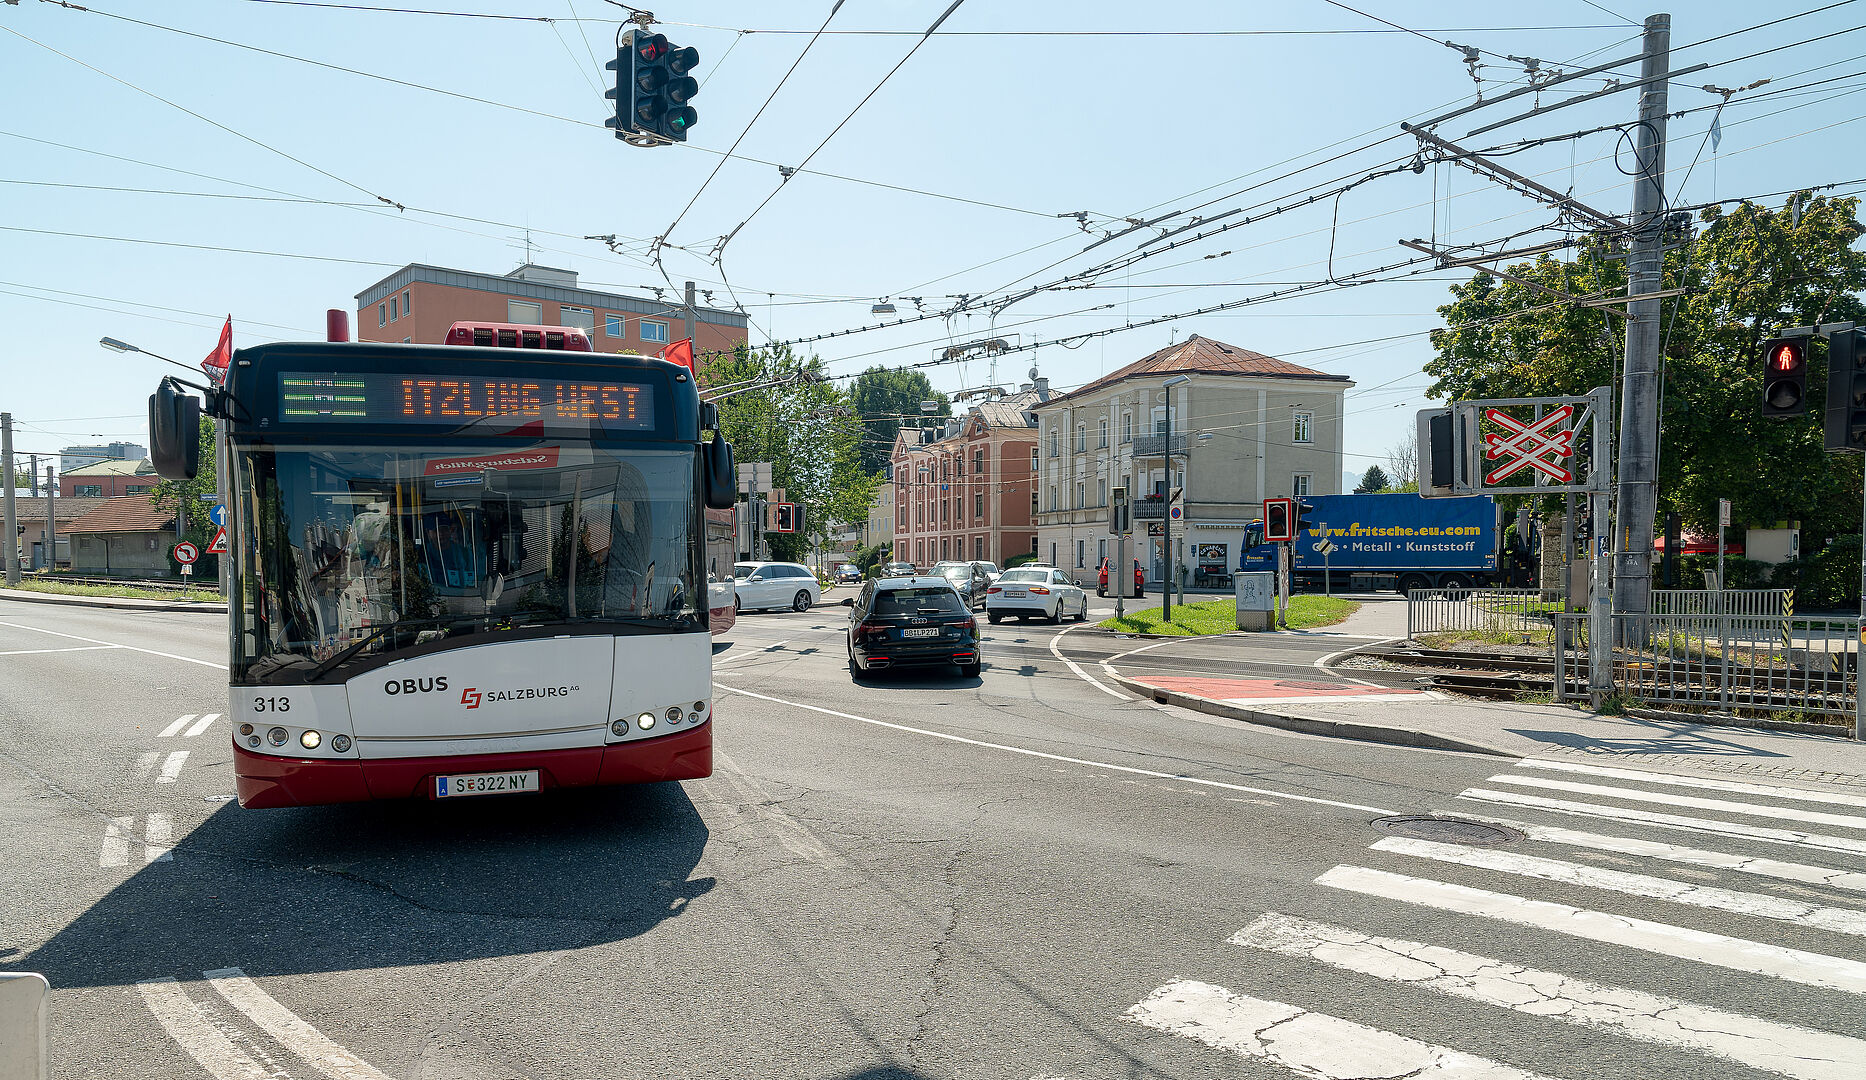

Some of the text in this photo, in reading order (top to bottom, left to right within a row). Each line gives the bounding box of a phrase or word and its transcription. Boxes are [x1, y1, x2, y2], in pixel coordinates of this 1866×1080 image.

[402, 380, 540, 416] ITZLING
[556, 385, 640, 418] WEST
[1308, 522, 1480, 536] www.fritsche.eu.com
[1352, 541, 1391, 552] Metall
[1406, 541, 1475, 552] Kunststoff
[384, 676, 449, 696] OBUS
[487, 686, 568, 702] SALZBURG
[254, 697, 290, 712] 313
[456, 779, 465, 792] S
[477, 776, 505, 791] 322
[509, 774, 527, 789] NY
